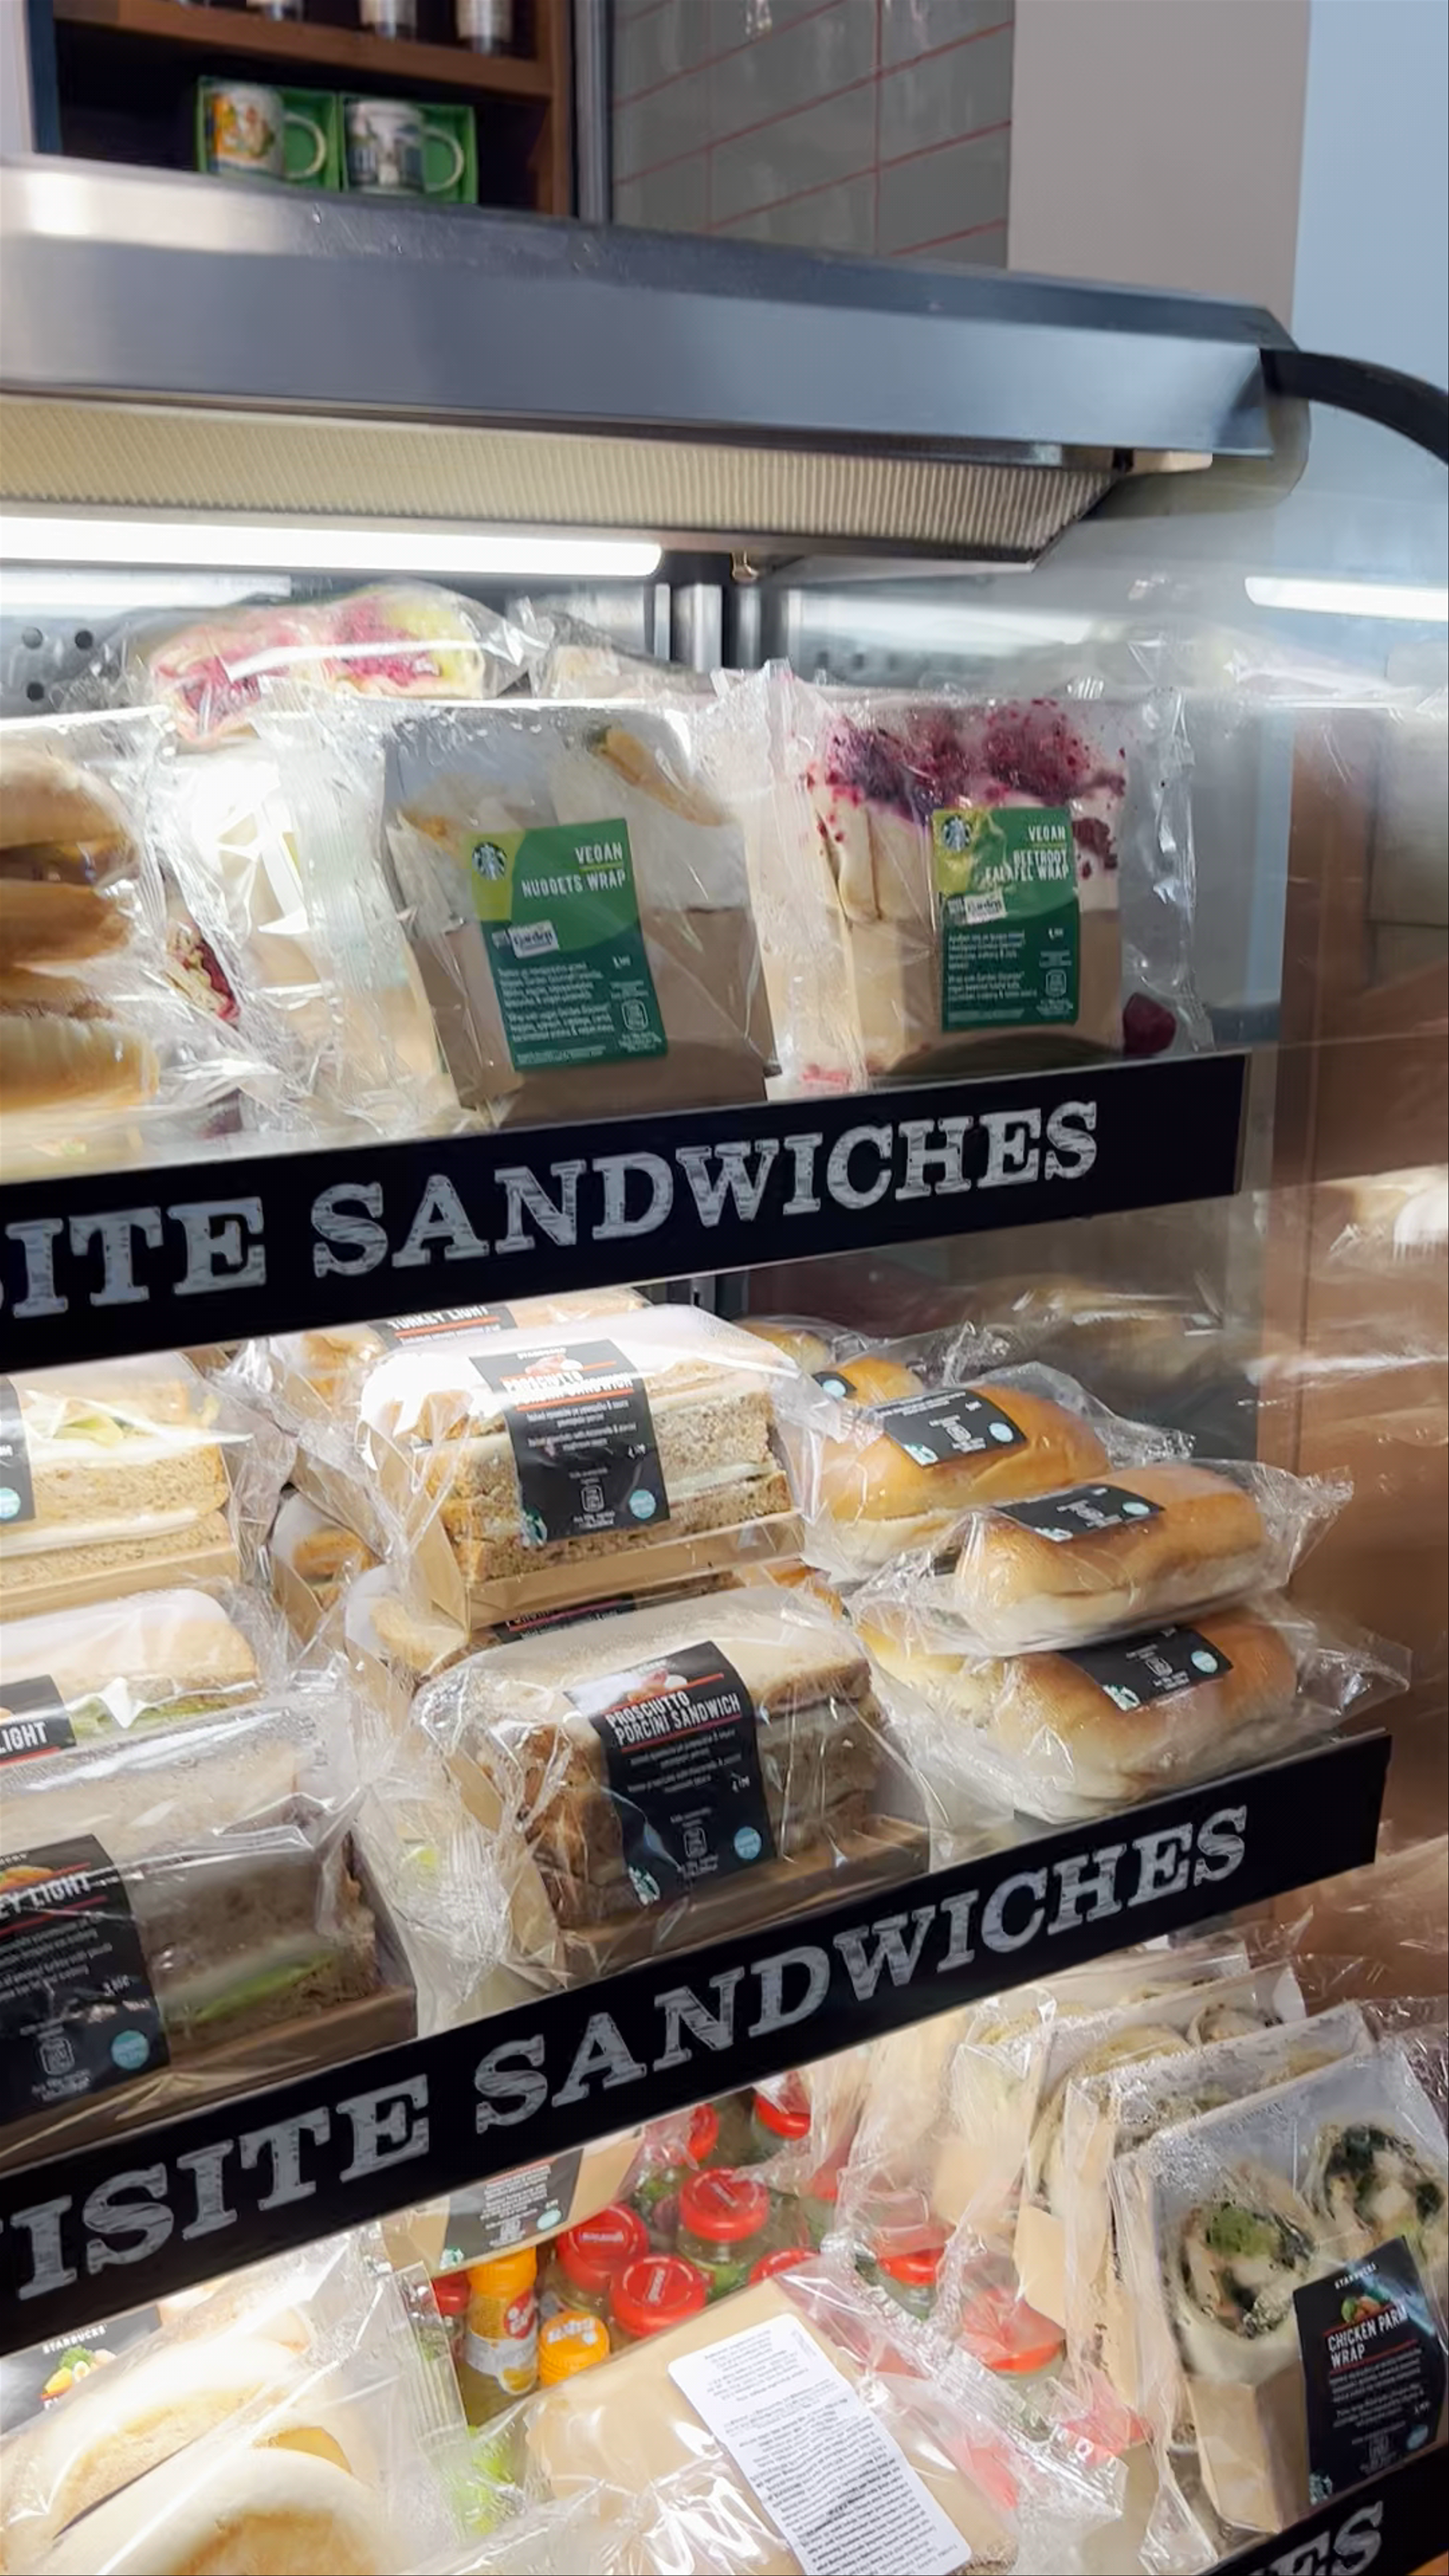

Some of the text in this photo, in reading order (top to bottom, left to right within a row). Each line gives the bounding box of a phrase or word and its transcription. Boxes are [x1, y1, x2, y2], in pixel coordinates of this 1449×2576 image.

[1028, 825, 1066, 842] VEGAN
[575, 841, 623, 864] VEGAN
[521, 868, 626, 898] NUGGETS WRAP
[0, 1101, 1098, 1318] ITE SANDWICHES
[387, 1311, 445, 1330] TURKEY
[605, 1690, 690, 1727] PROSCIUTTO
[614, 1693, 741, 1746] PORCINI SANDWICH
[27, 1872, 91, 1907] LIGHT
[0, 1805, 1247, 2301] ISITE SANDWICHES
[1328, 2302, 1408, 2352] CHICKEN PARM
[1331, 2343, 1365, 2370] WRAP
[1247, 2501, 1383, 2576] ES
